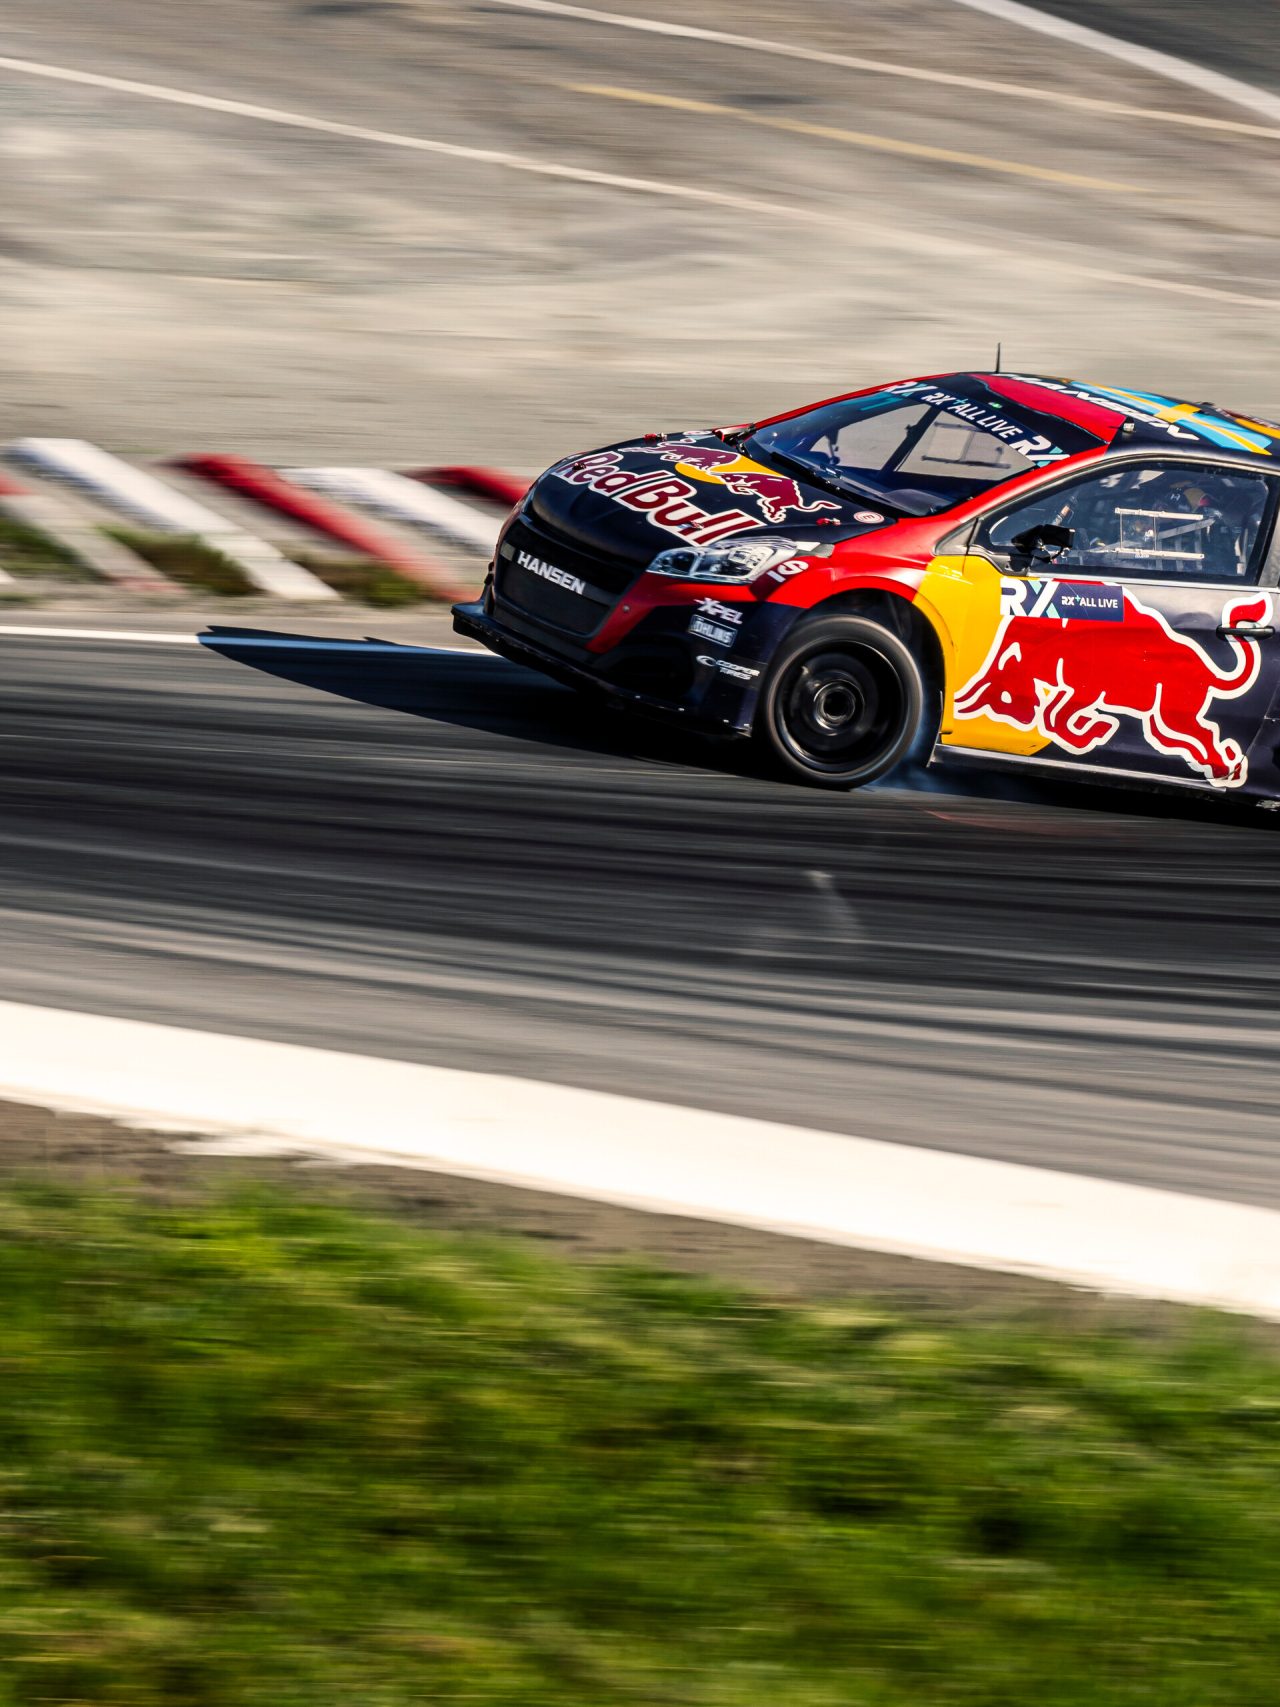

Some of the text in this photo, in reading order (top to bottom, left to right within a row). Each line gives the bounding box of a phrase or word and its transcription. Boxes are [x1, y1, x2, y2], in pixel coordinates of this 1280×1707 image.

[947, 401, 981, 420] ALL
[977, 415, 1023, 438] LIVE
[1009, 435, 1071, 467] RX
[517, 550, 586, 595] HANSEN
[694, 597, 743, 624] XPEL
[1000, 577, 1060, 619] RX
[1080, 598, 1097, 607] ALL
[1098, 598, 1118, 608] LIVE
